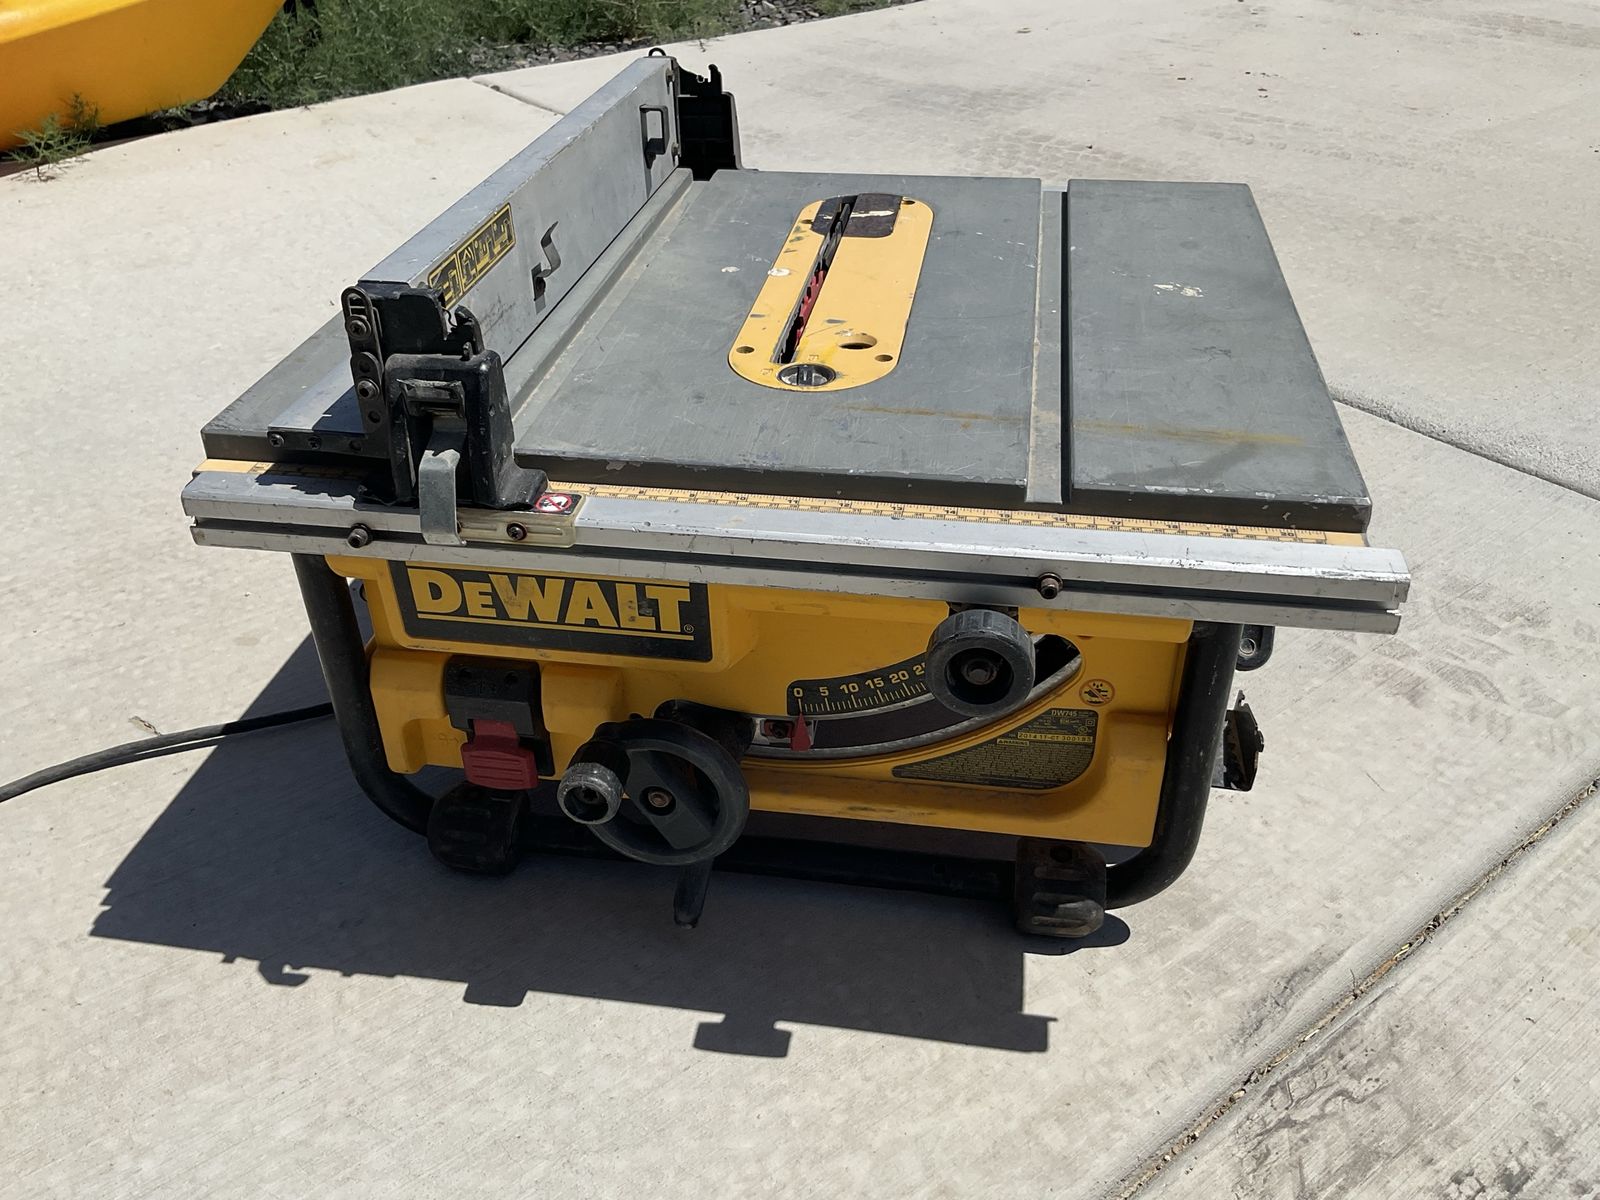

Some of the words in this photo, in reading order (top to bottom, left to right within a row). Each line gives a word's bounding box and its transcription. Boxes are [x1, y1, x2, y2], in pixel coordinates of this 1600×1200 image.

[407, 568, 691, 633] DEWALT
[793, 687, 803, 698] 0
[820, 686, 830, 696] 5
[840, 682, 859, 694] 10
[864, 678, 884, 689] 15
[888, 670, 909, 684] 20
